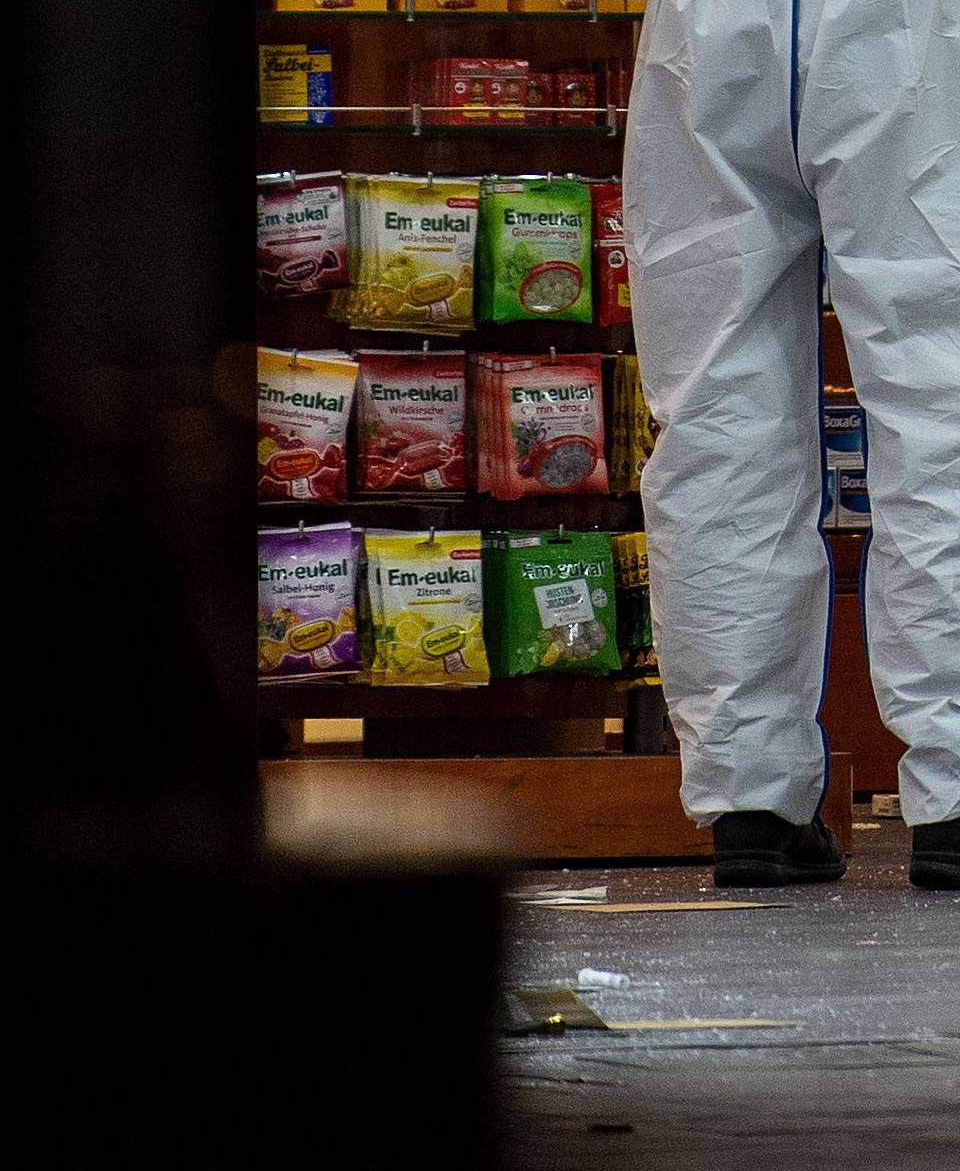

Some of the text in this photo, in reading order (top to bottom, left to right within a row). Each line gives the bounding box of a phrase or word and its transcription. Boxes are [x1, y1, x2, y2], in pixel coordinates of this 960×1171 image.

[370, 383, 459, 403] Em-eukal
[258, 559, 348, 582] Em-eukal
[388, 566, 477, 586] Em-eukal
[416, 588, 451, 597] Zitrone
